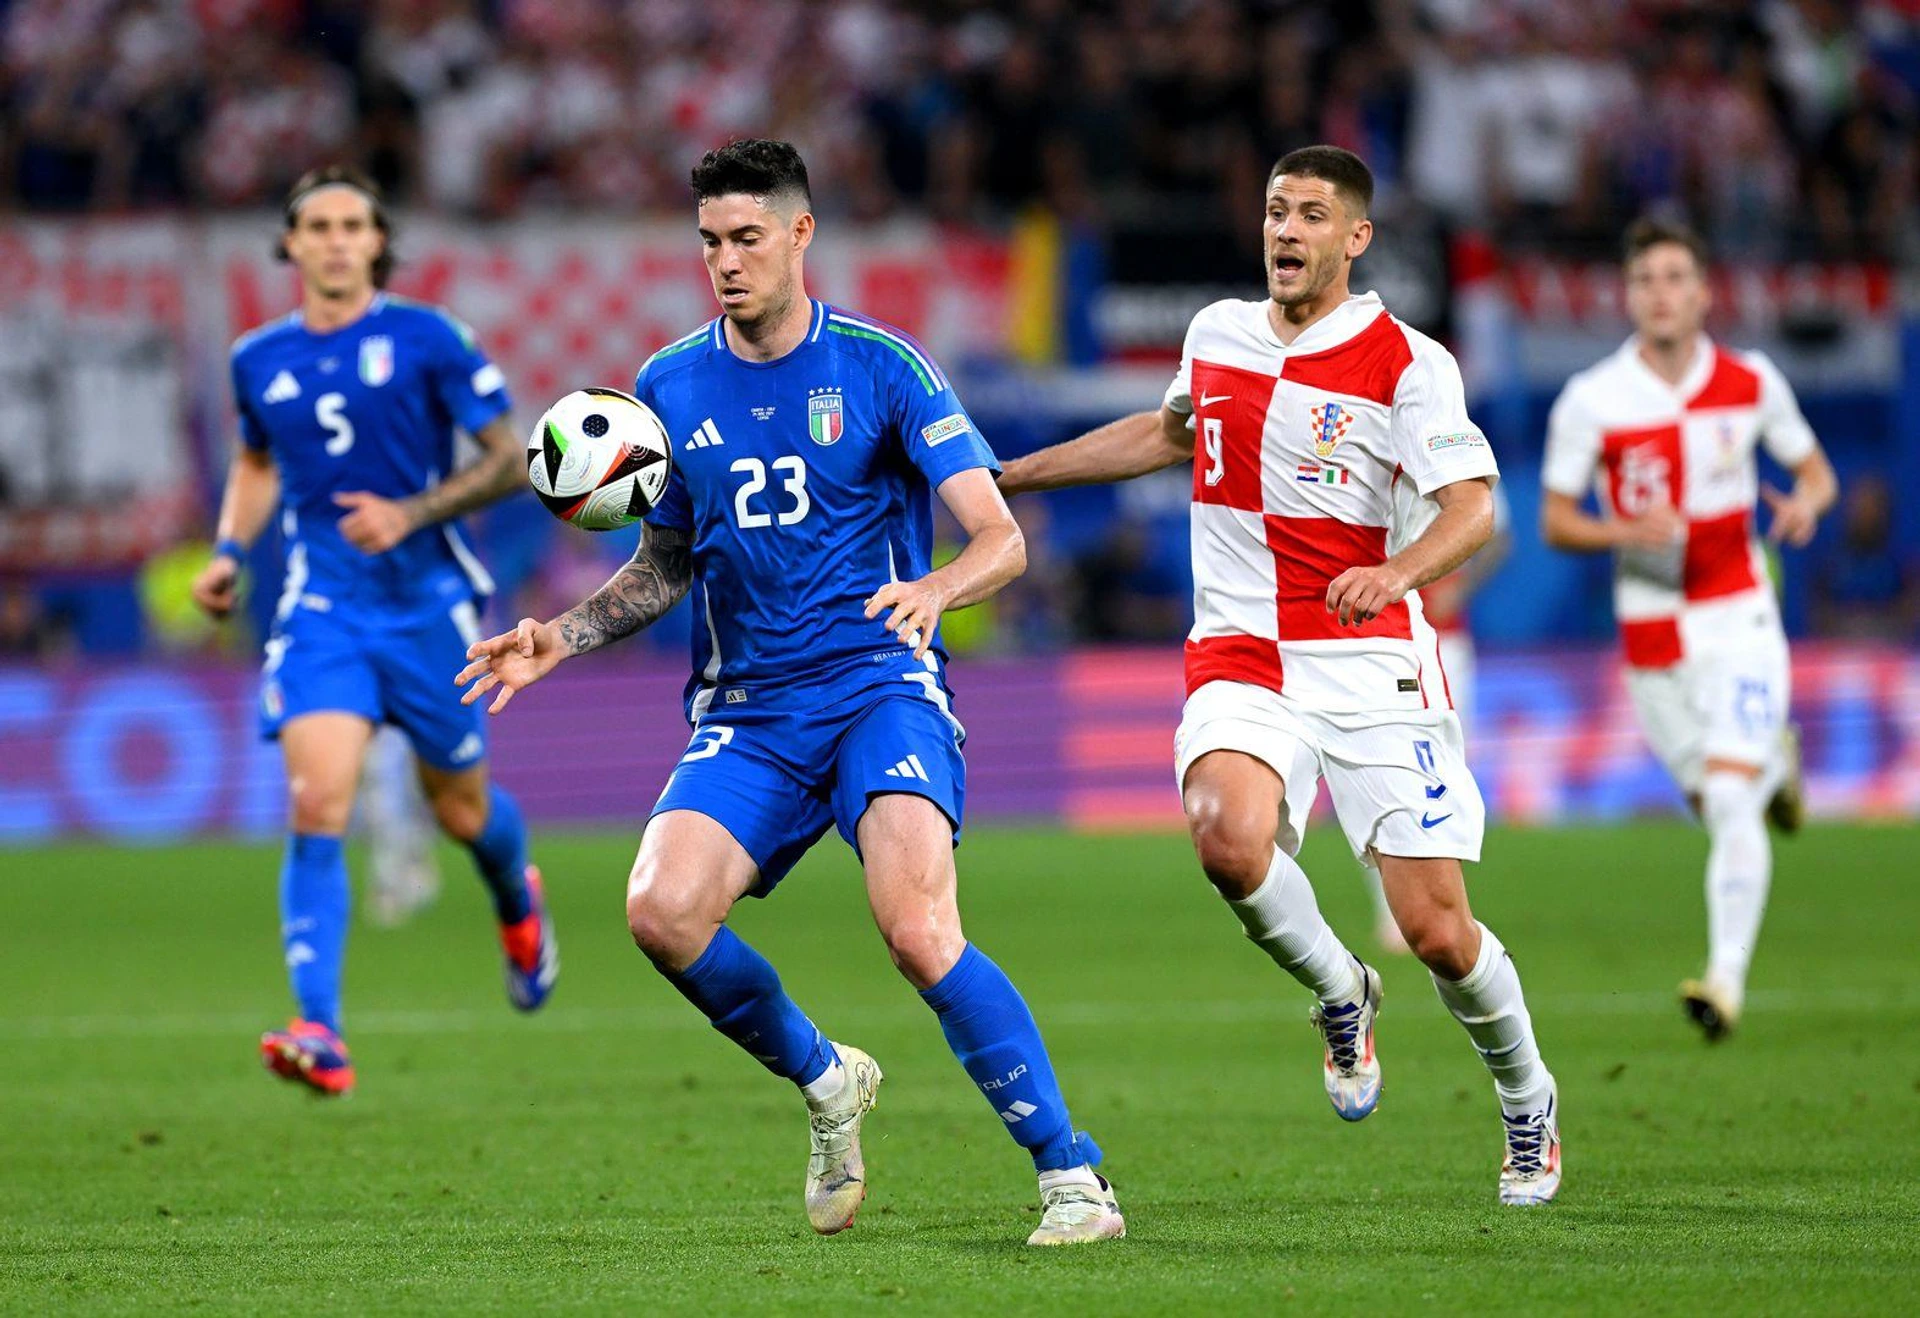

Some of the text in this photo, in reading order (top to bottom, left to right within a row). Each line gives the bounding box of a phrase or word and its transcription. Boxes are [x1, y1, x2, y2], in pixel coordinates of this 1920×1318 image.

[315, 392, 355, 457] 5
[811, 399, 840, 411] ITALIA
[1203, 418, 1225, 486] 9
[730, 455, 811, 529] 23
[1413, 740, 1448, 801] 9
[981, 1064, 1027, 1091] ALIA
